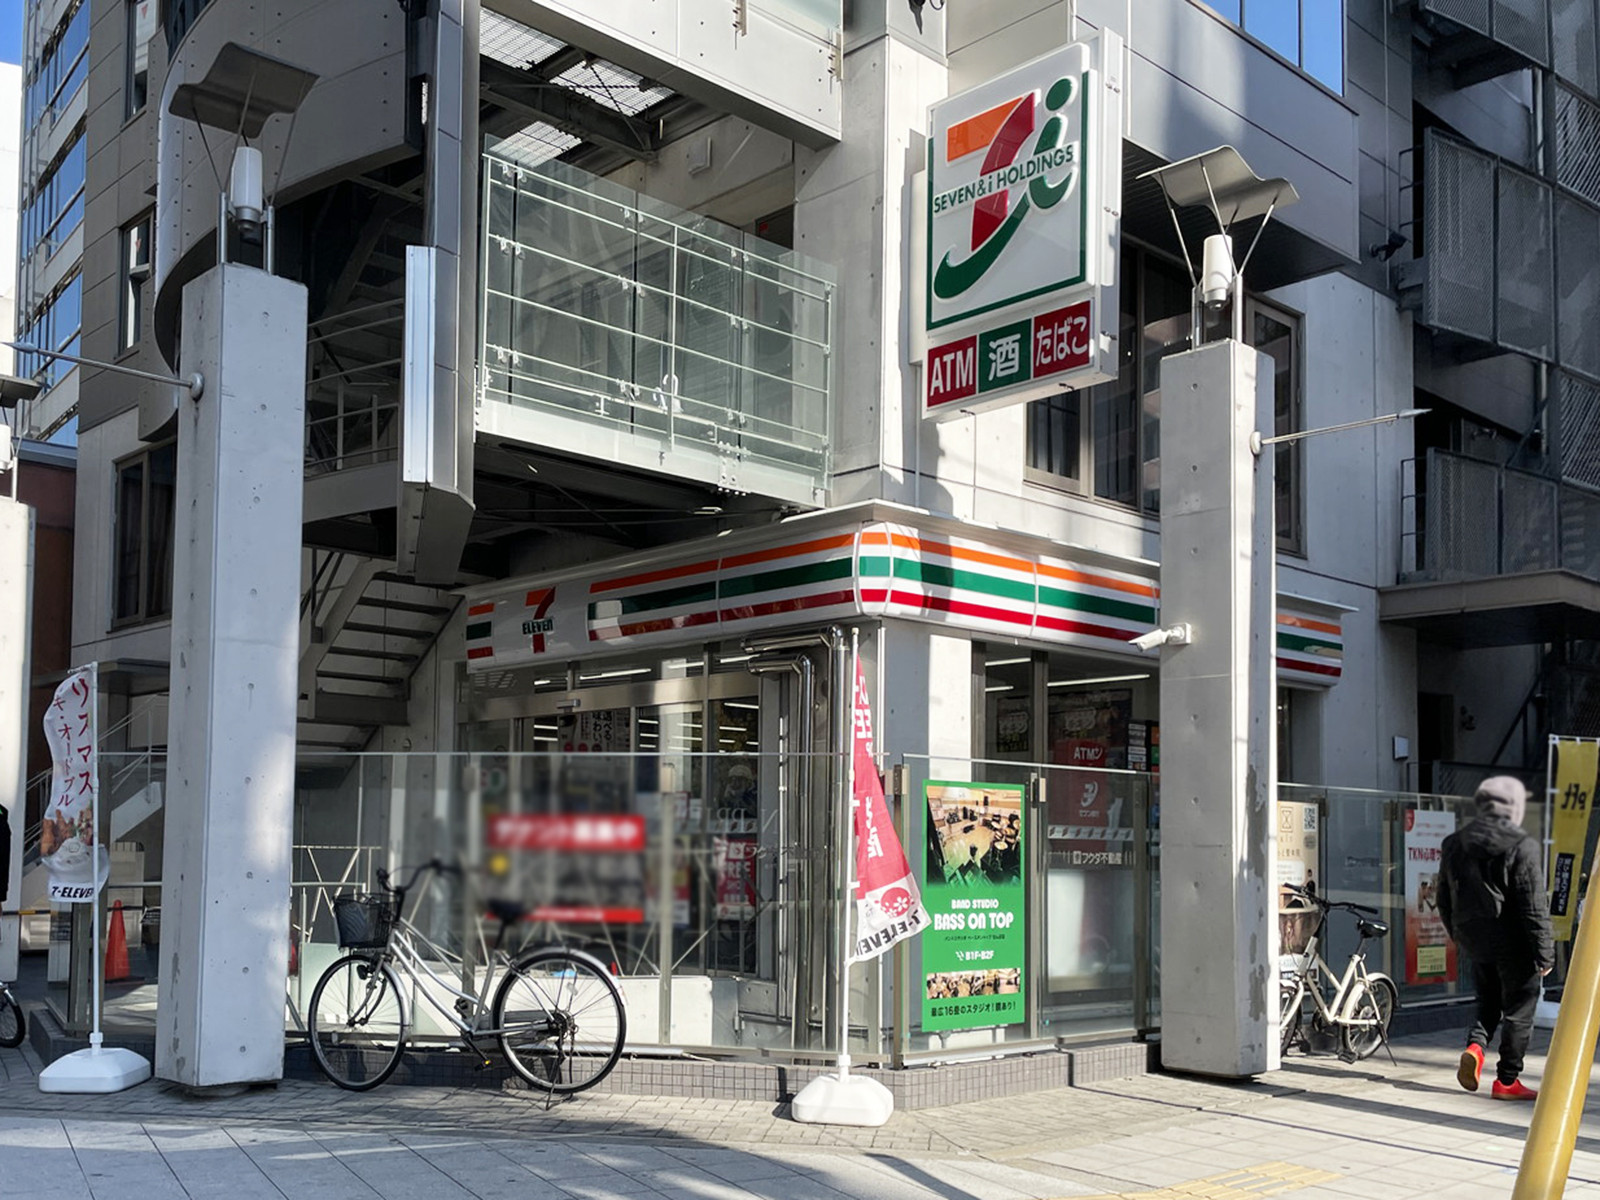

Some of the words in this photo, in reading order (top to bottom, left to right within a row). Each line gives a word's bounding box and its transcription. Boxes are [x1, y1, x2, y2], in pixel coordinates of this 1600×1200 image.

[997, 144, 1074, 187] HOLDINGS
[929, 346, 974, 397] ATM
[988, 333, 1021, 382] 酒
[1036, 316, 1089, 367] たばこ
[1073, 747, 1096, 760] ATM
[51, 885, 95, 899] 7-ELEVE
[951, 899, 971, 909] BAND
[973, 899, 999, 909] STUDIO
[934, 913, 965, 931] BASS
[968, 913, 986, 930] ON
[988, 912, 1014, 929] TOP
